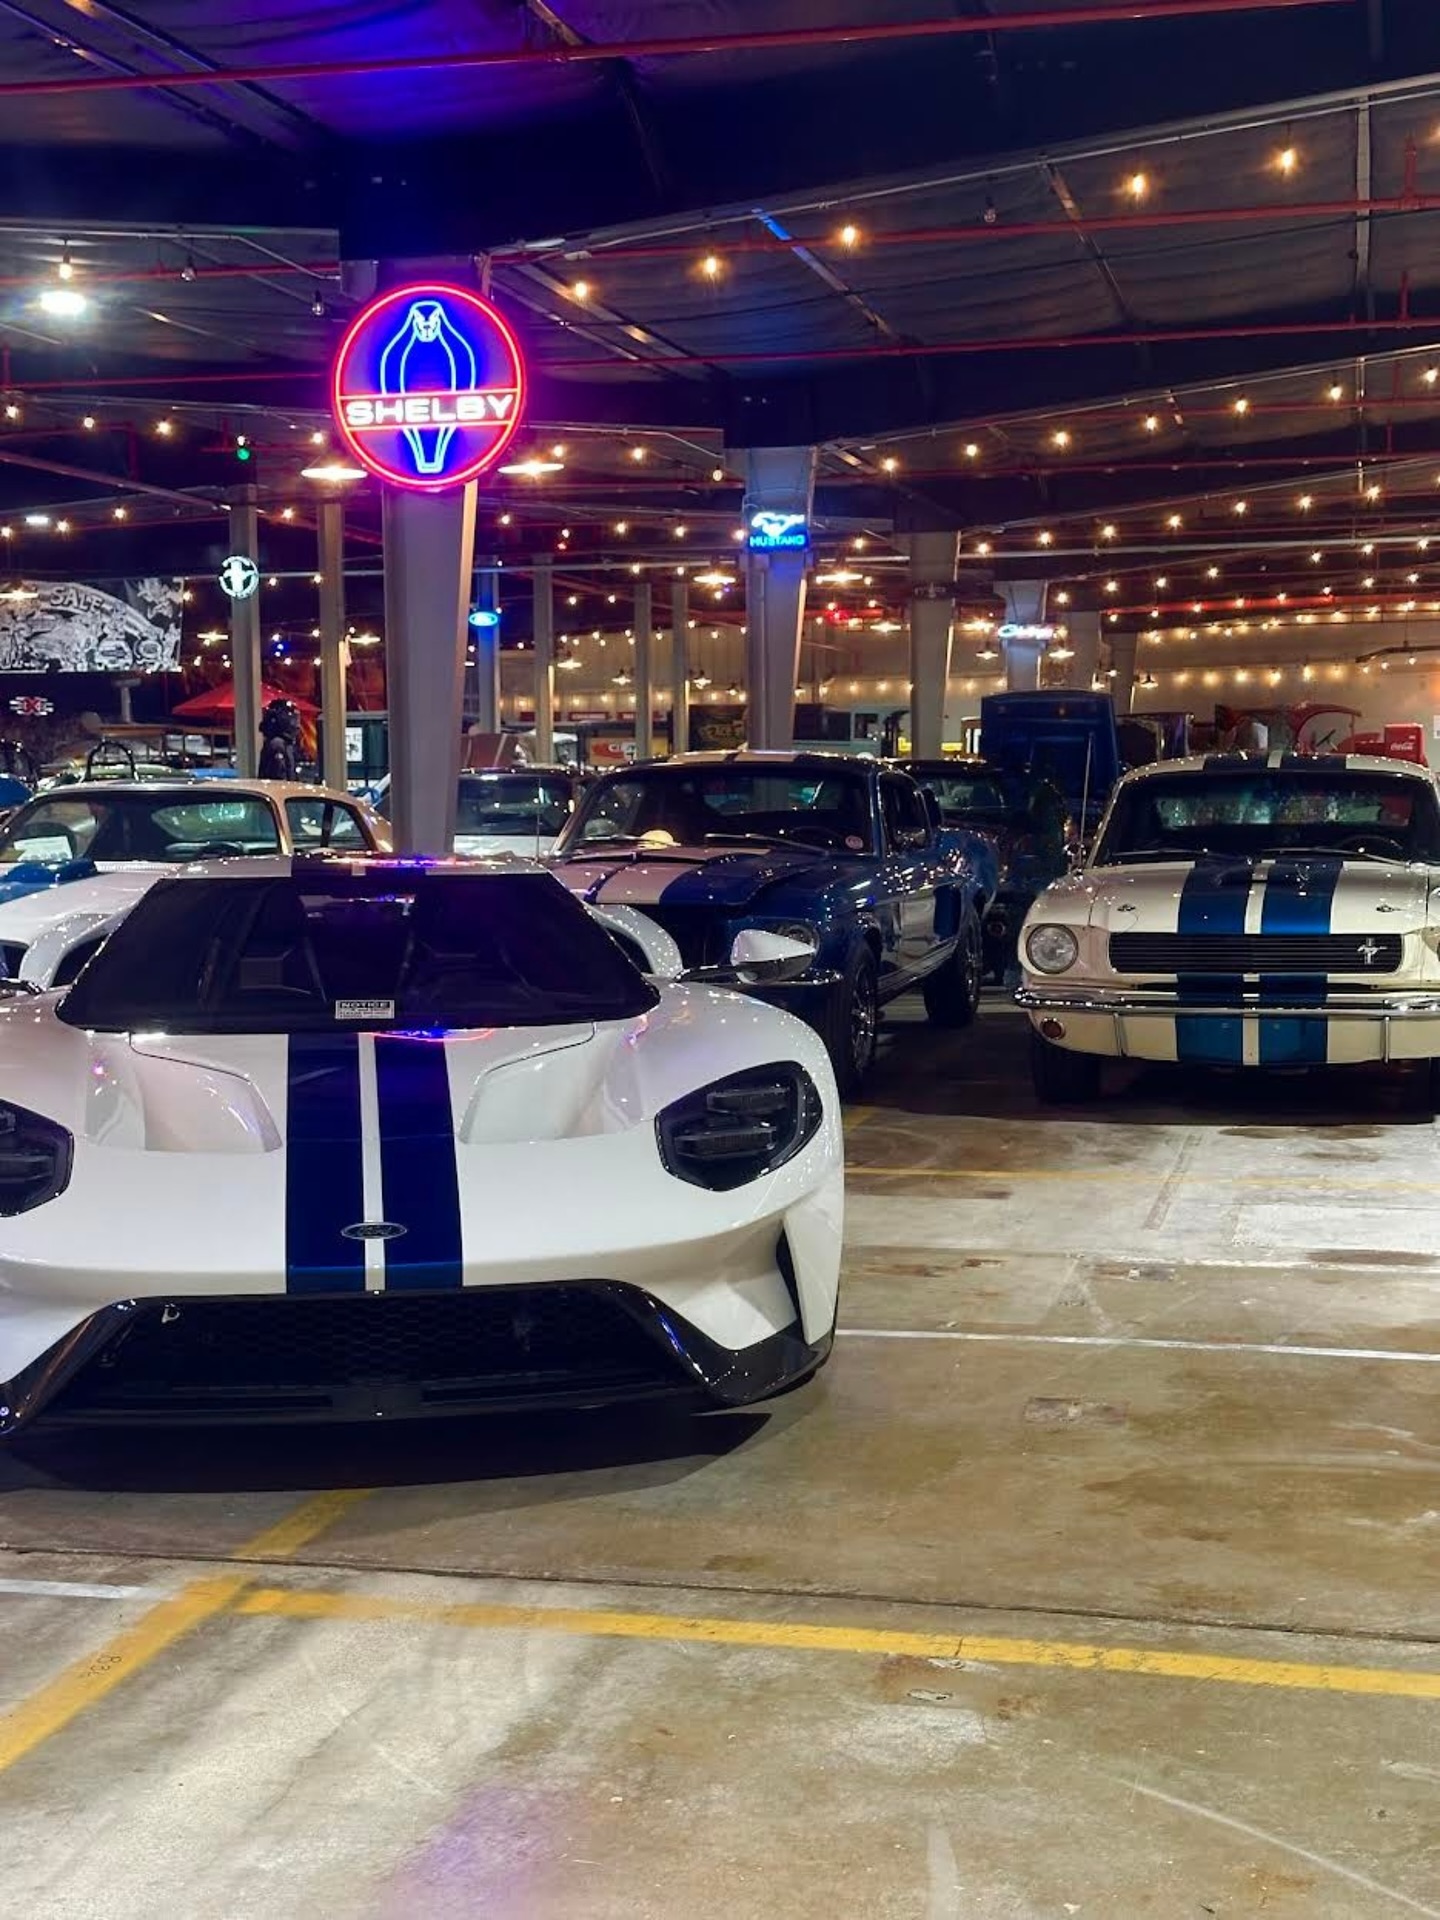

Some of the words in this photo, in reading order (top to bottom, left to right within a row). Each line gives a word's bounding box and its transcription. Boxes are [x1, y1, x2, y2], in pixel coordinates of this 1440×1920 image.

[346, 394, 513, 426] SHELBY
[749, 534, 805, 547] MUSTANG
[50, 586, 103, 611] SALE
